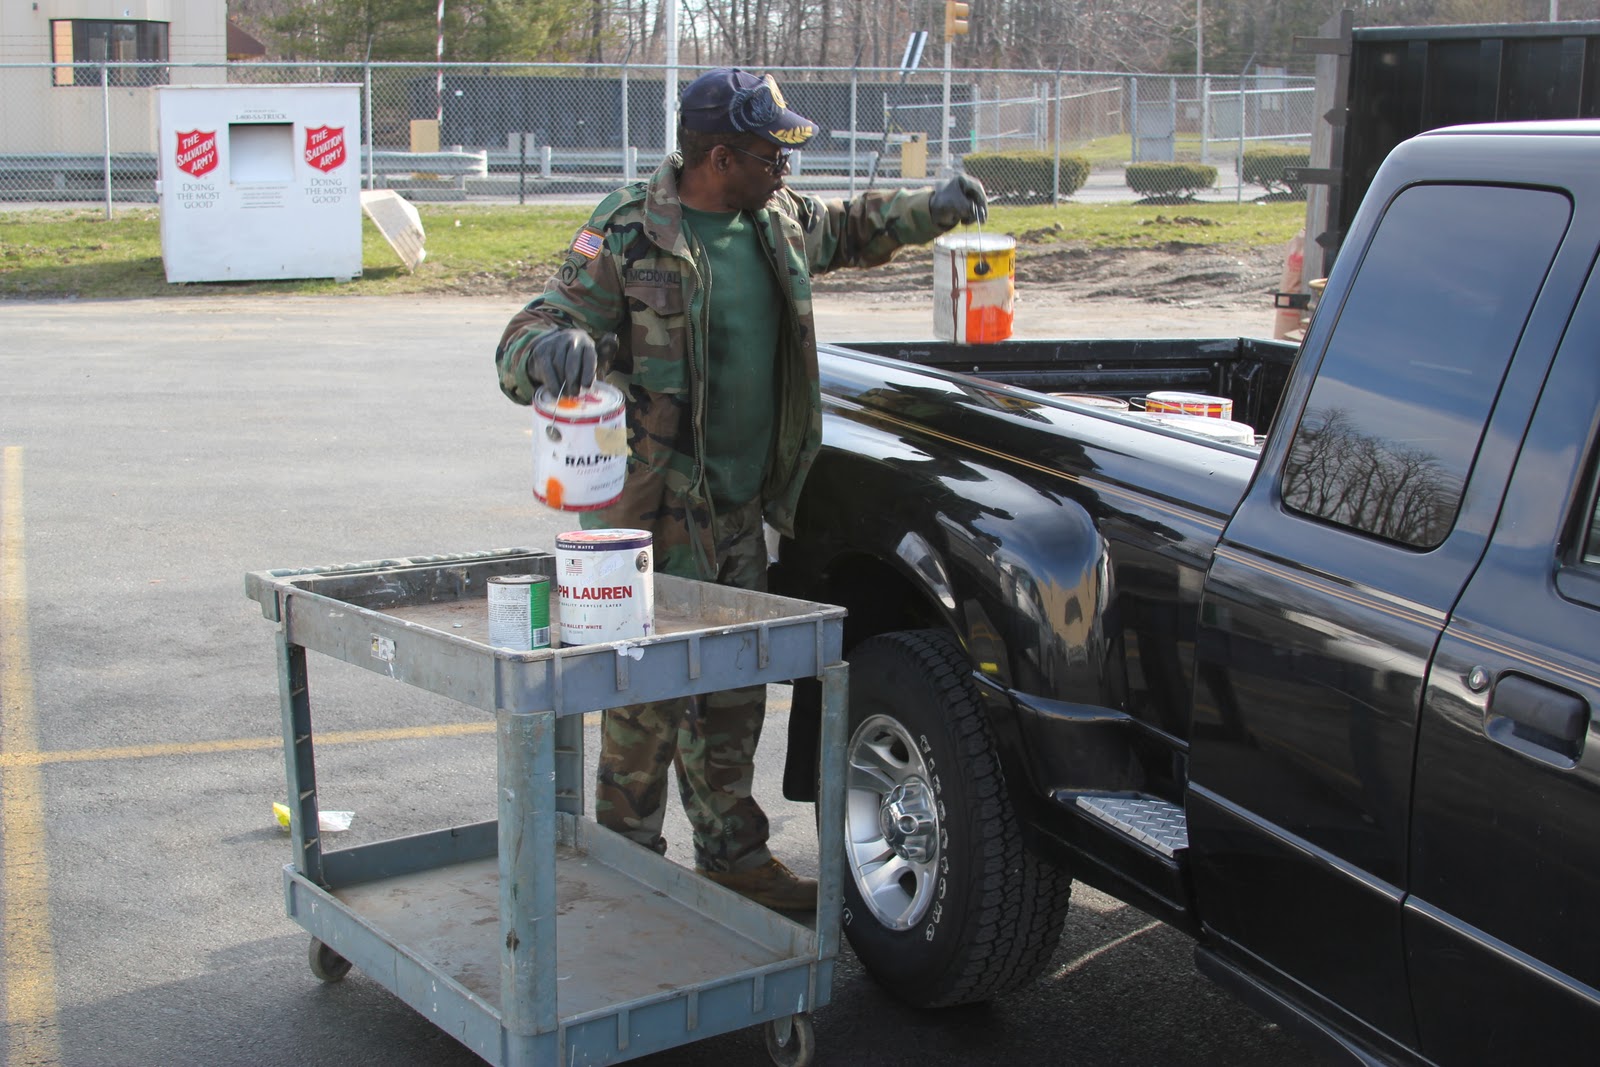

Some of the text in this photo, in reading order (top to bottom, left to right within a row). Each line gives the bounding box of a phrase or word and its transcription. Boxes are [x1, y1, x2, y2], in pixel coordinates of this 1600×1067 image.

[182, 133, 200, 149] THE
[311, 129, 328, 145] THE
[177, 136, 215, 167] SALVATION
[305, 132, 342, 162] SALVATION
[190, 150, 215, 173] ARMY
[320, 146, 343, 168] ARMY
[182, 183, 215, 192] DOING
[311, 178, 343, 187] DOING
[196, 192, 220, 200] MOST
[323, 187, 347, 195] MOST
[184, 200, 213, 209] GOOD
[312, 195, 341, 204] GOOD
[573, 585, 633, 600] LAUREN
